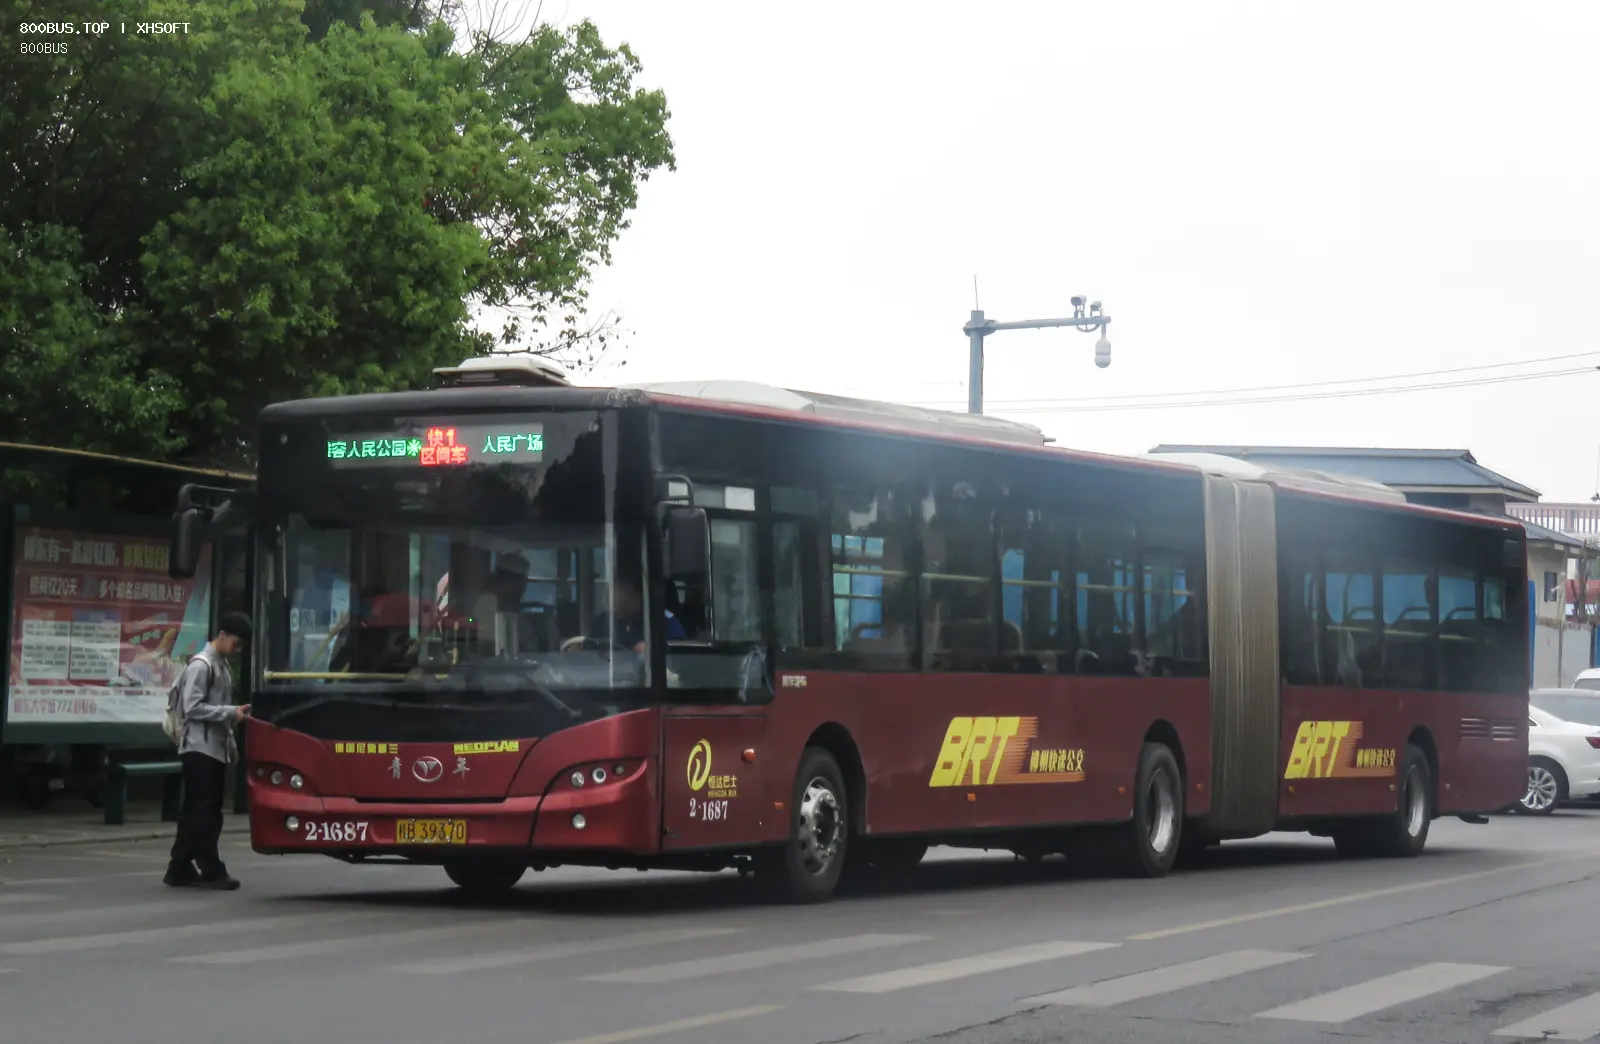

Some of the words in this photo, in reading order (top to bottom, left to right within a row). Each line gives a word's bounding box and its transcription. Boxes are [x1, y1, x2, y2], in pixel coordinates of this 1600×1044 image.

[427, 428, 456, 447] 快1
[482, 433, 544, 453] 人民广场
[420, 446, 468, 466] 区间车
[453, 740, 520, 755] NEOPLAN
[928, 715, 1021, 788] BRT
[1283, 720, 1351, 779] BRT
[304, 821, 369, 843] 2-1687
